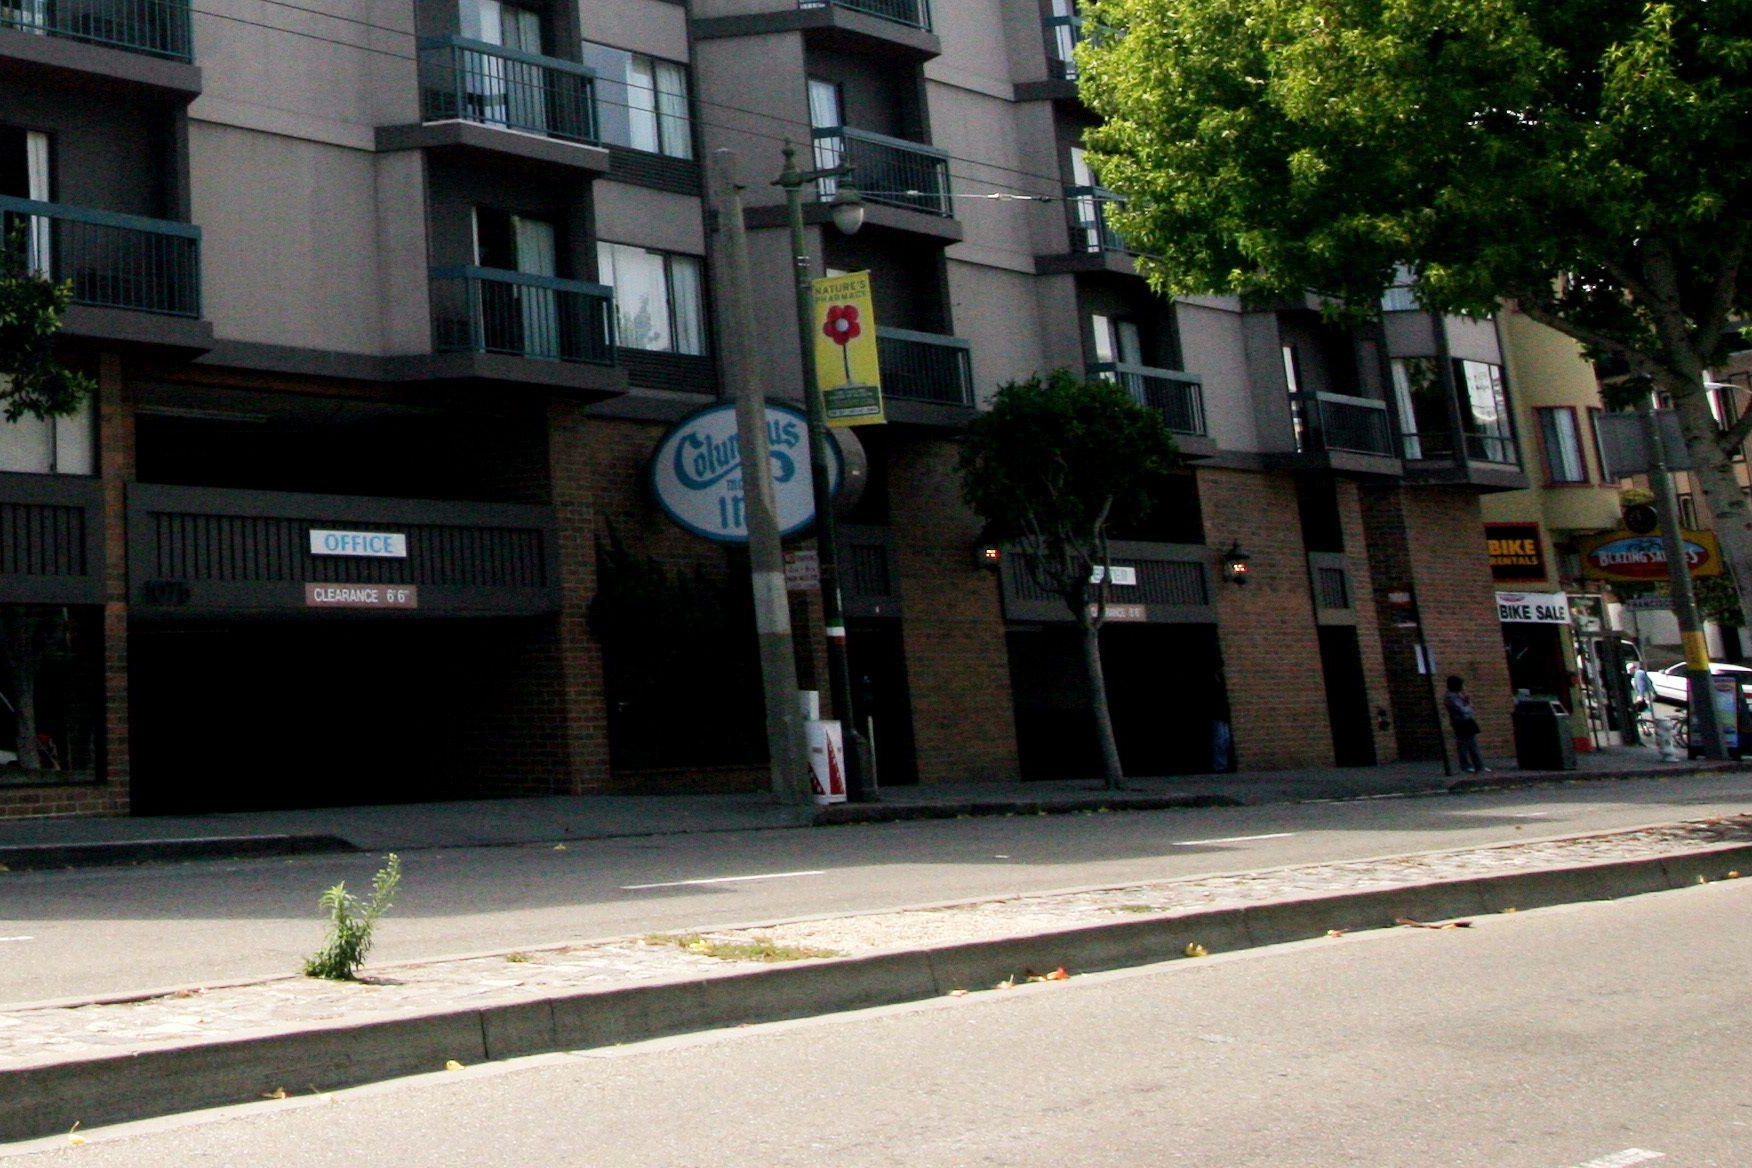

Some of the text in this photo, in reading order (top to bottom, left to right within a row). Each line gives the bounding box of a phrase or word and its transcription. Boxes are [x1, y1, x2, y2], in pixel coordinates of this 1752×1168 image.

[814, 280, 866, 295] NATURE'S
[324, 534, 394, 553] OFFICE
[1487, 539, 1536, 555] BIKE
[314, 588, 379, 603] CLEARANCE
[1499, 604, 1566, 620] BIKE SALE
